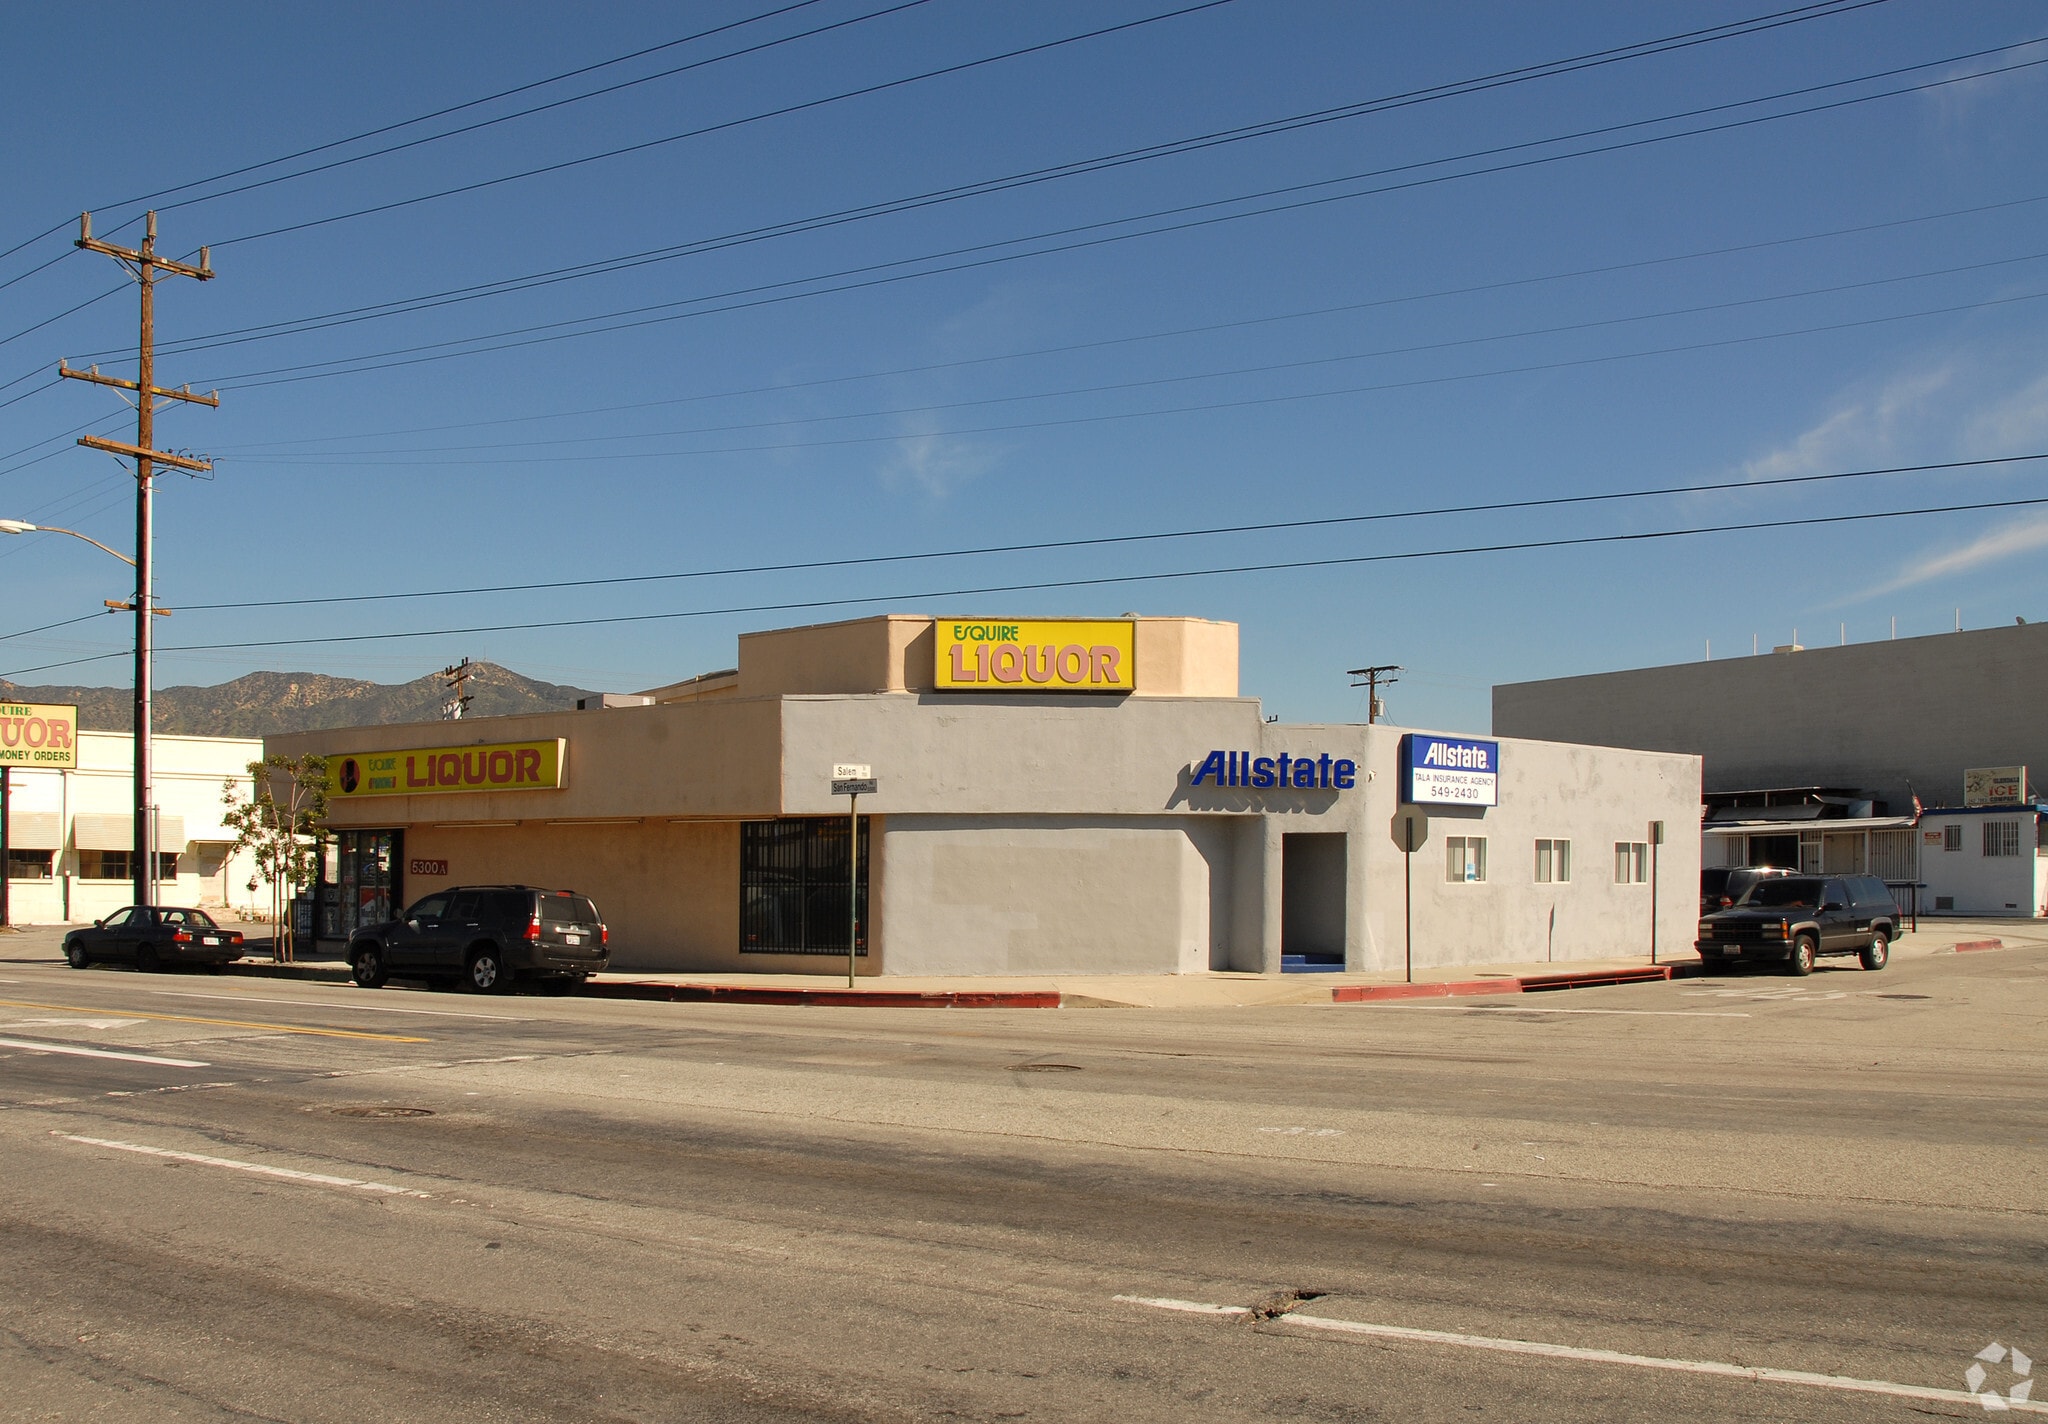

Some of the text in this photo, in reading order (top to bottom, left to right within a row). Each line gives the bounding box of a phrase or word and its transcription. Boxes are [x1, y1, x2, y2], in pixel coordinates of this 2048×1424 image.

[954, 625, 1018, 641] ESQUIRE
[949, 644, 1121, 683] LIQUOR
[0, 705, 32, 716] UIRE
[34, 751, 71, 761] ORDERS
[1423, 742, 1488, 769] Allstate
[406, 749, 541, 788] LIQUOR
[838, 766, 857, 776] Salem
[1190, 750, 1355, 789] Allstate
[1415, 773, 1495, 786] TALA INSURANCE AGENCY
[833, 783, 843, 792] San
[844, 782, 867, 791] Fernando
[1431, 785, 1478, 799] 549-2430
[1989, 785, 2018, 796] ICE
[412, 861, 439, 874] 5300
